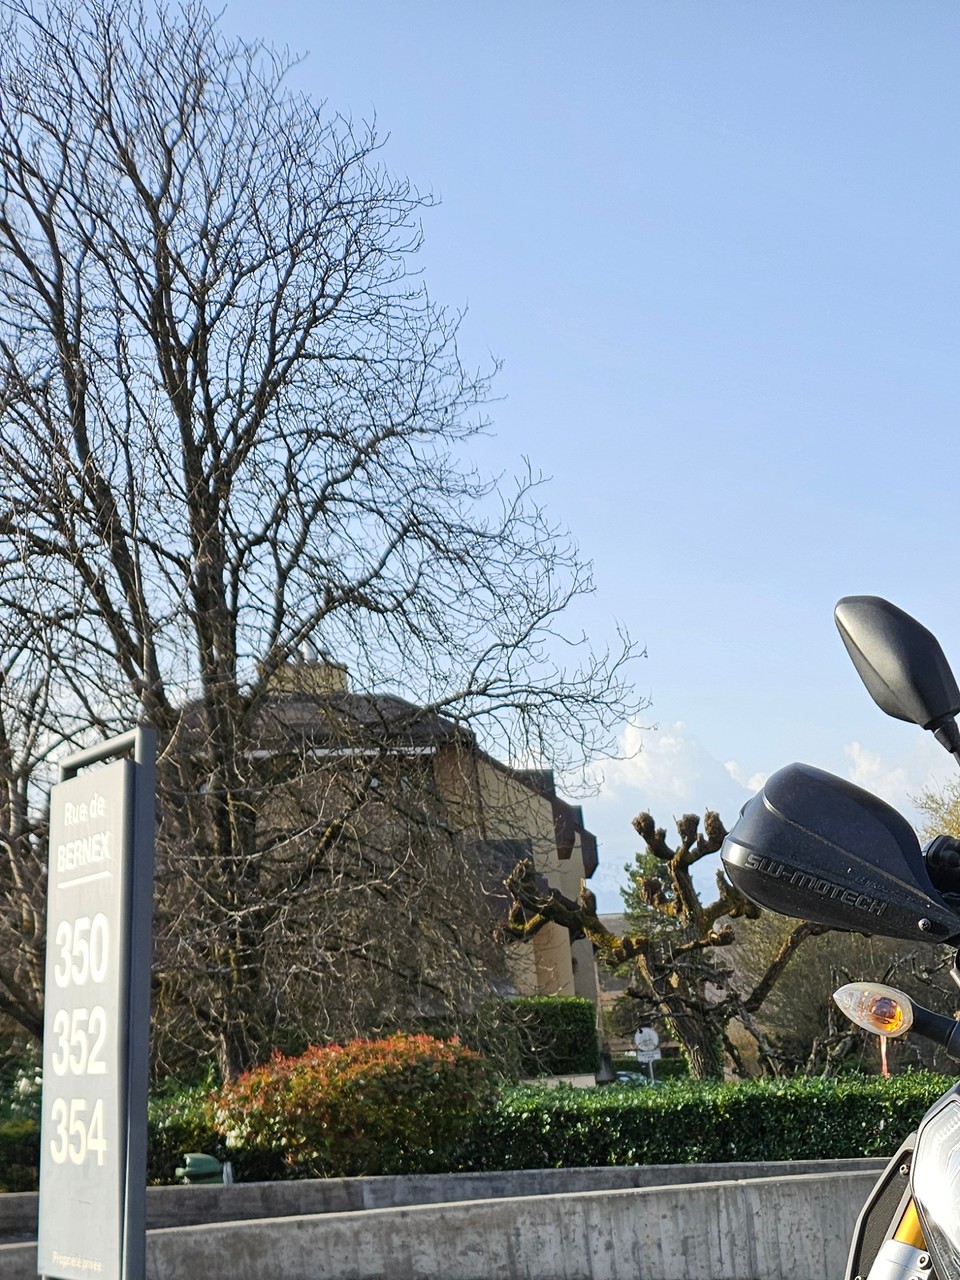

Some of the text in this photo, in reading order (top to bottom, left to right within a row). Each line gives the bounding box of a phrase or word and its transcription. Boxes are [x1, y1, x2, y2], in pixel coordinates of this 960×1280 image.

[64, 792, 106, 826] Rue de
[57, 830, 112, 873] BERNEX
[744, 853, 889, 916] SW-MOTECH
[54, 912, 110, 988] 350
[52, 1005, 108, 1077] 352
[50, 1098, 107, 1166] 354
